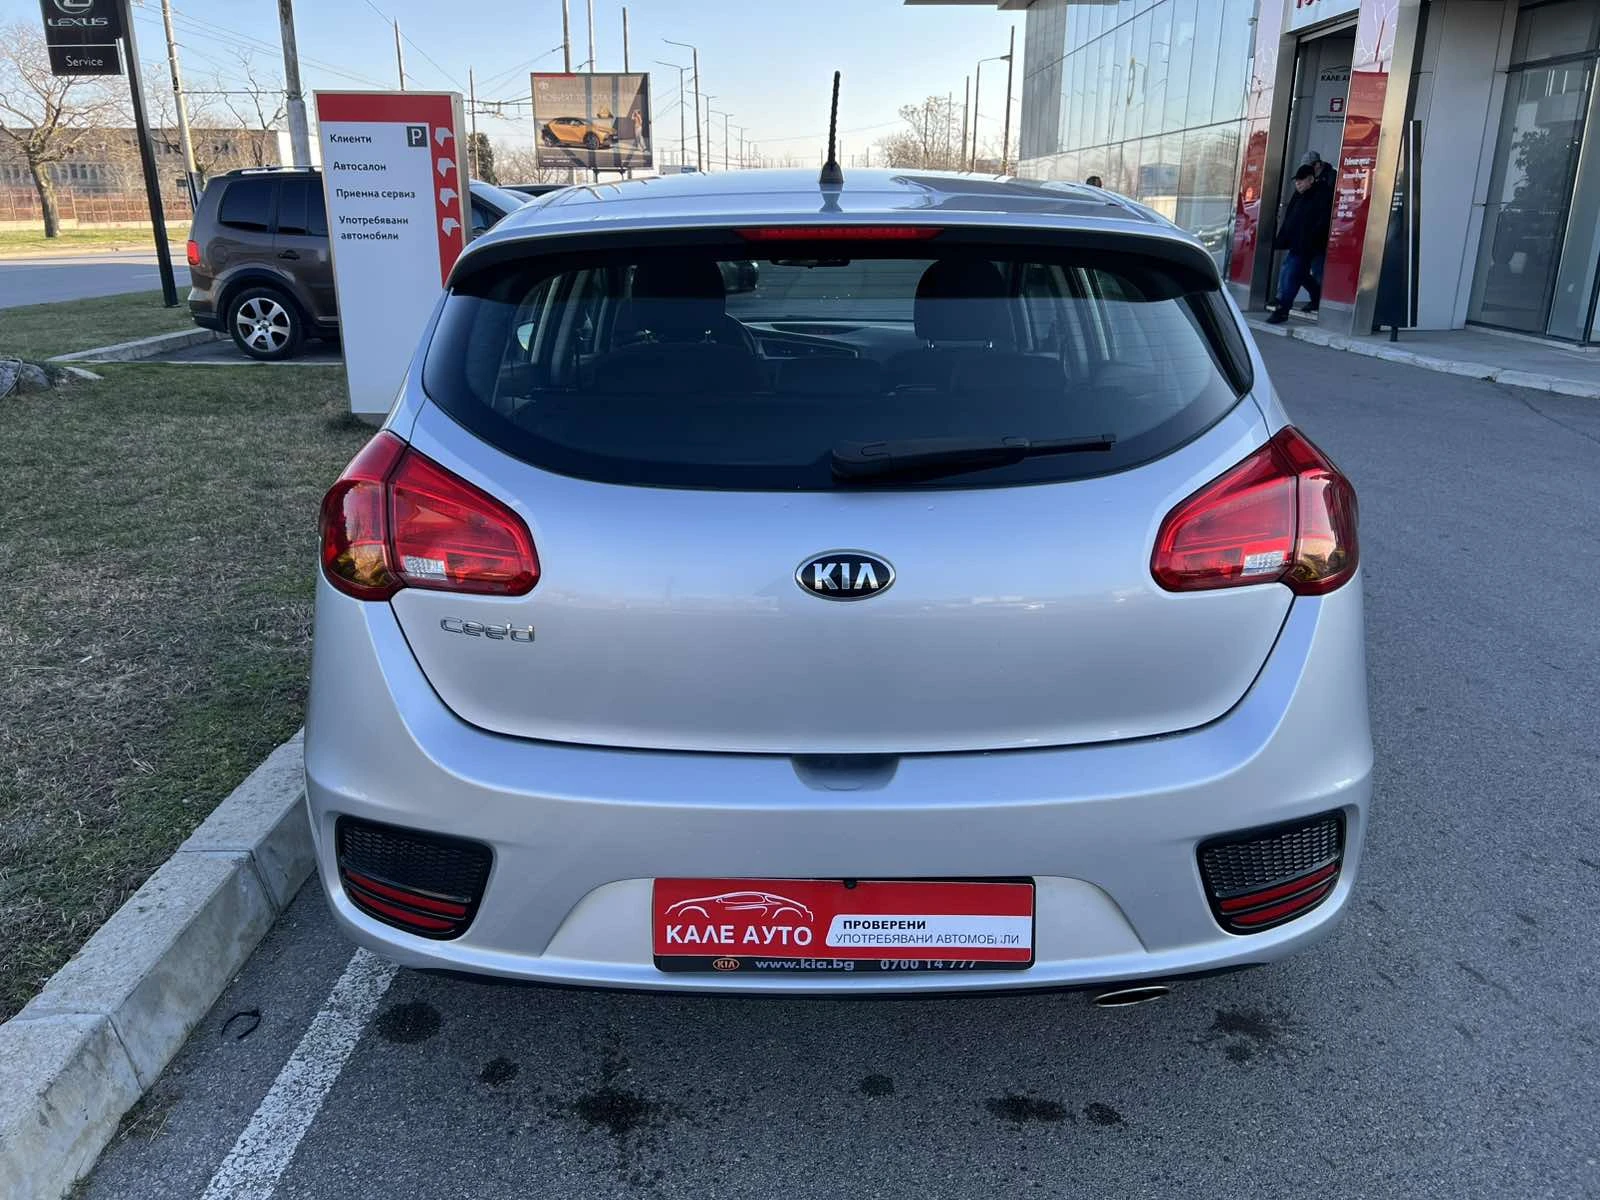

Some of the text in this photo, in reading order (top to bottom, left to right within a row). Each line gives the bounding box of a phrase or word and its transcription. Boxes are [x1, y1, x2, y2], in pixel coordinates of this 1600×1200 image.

[47, 17, 109, 27] LEXUS
[65, 55, 104, 67] Service
[329, 134, 372, 144] Клиенти
[333, 161, 386, 172] Автосалон
[336, 188, 416, 201] Приемна сервиз
[338, 215, 409, 226] Употребявани
[340, 231, 399, 241] автомобили
[813, 562, 879, 590] KIA
[440, 616, 535, 643] Cee'd
[843, 920, 926, 930] ПРОВЕРЕНИ
[666, 925, 813, 946] КАЛЕ АУТО
[835, 933, 933, 944] УПОТРЕБЯВАНИ
[755, 959, 855, 971] www.kia.bg
[880, 960, 919, 970] 0700
